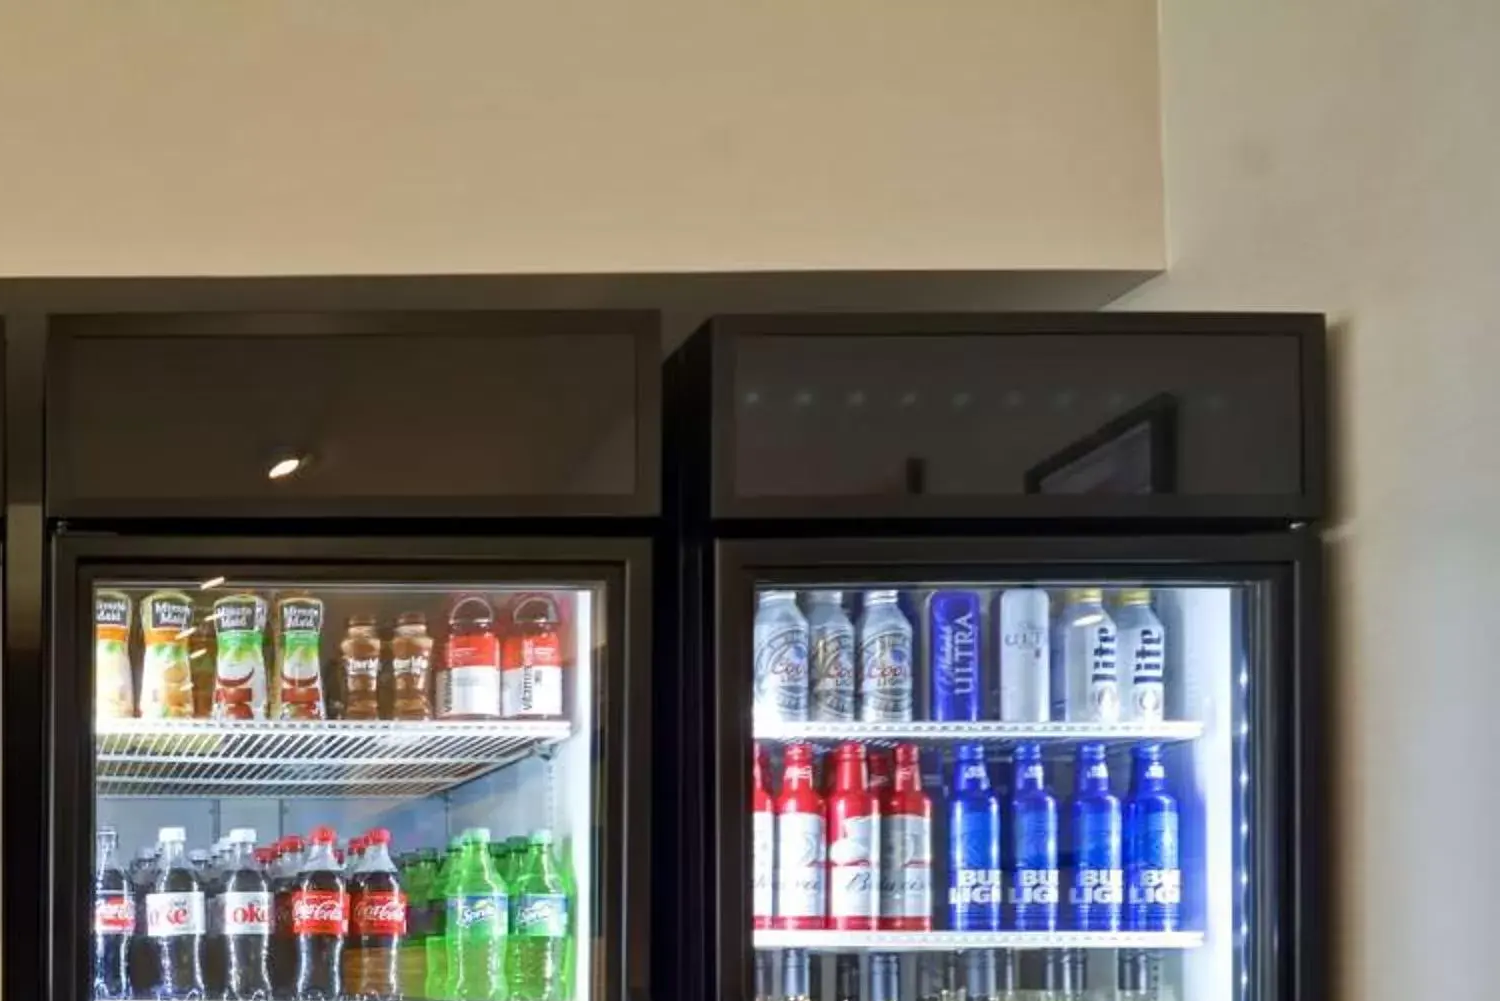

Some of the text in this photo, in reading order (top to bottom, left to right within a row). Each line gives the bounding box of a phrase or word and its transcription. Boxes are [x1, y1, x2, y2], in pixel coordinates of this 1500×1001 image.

[954, 613, 975, 695] ULTRA
[958, 869, 1001, 887] BU
[1020, 869, 1059, 887] BU
[1080, 869, 1123, 887] BU
[948, 886, 1001, 905] LIG
[1009, 886, 1059, 905] LIG
[1069, 886, 1123, 905] LIG
